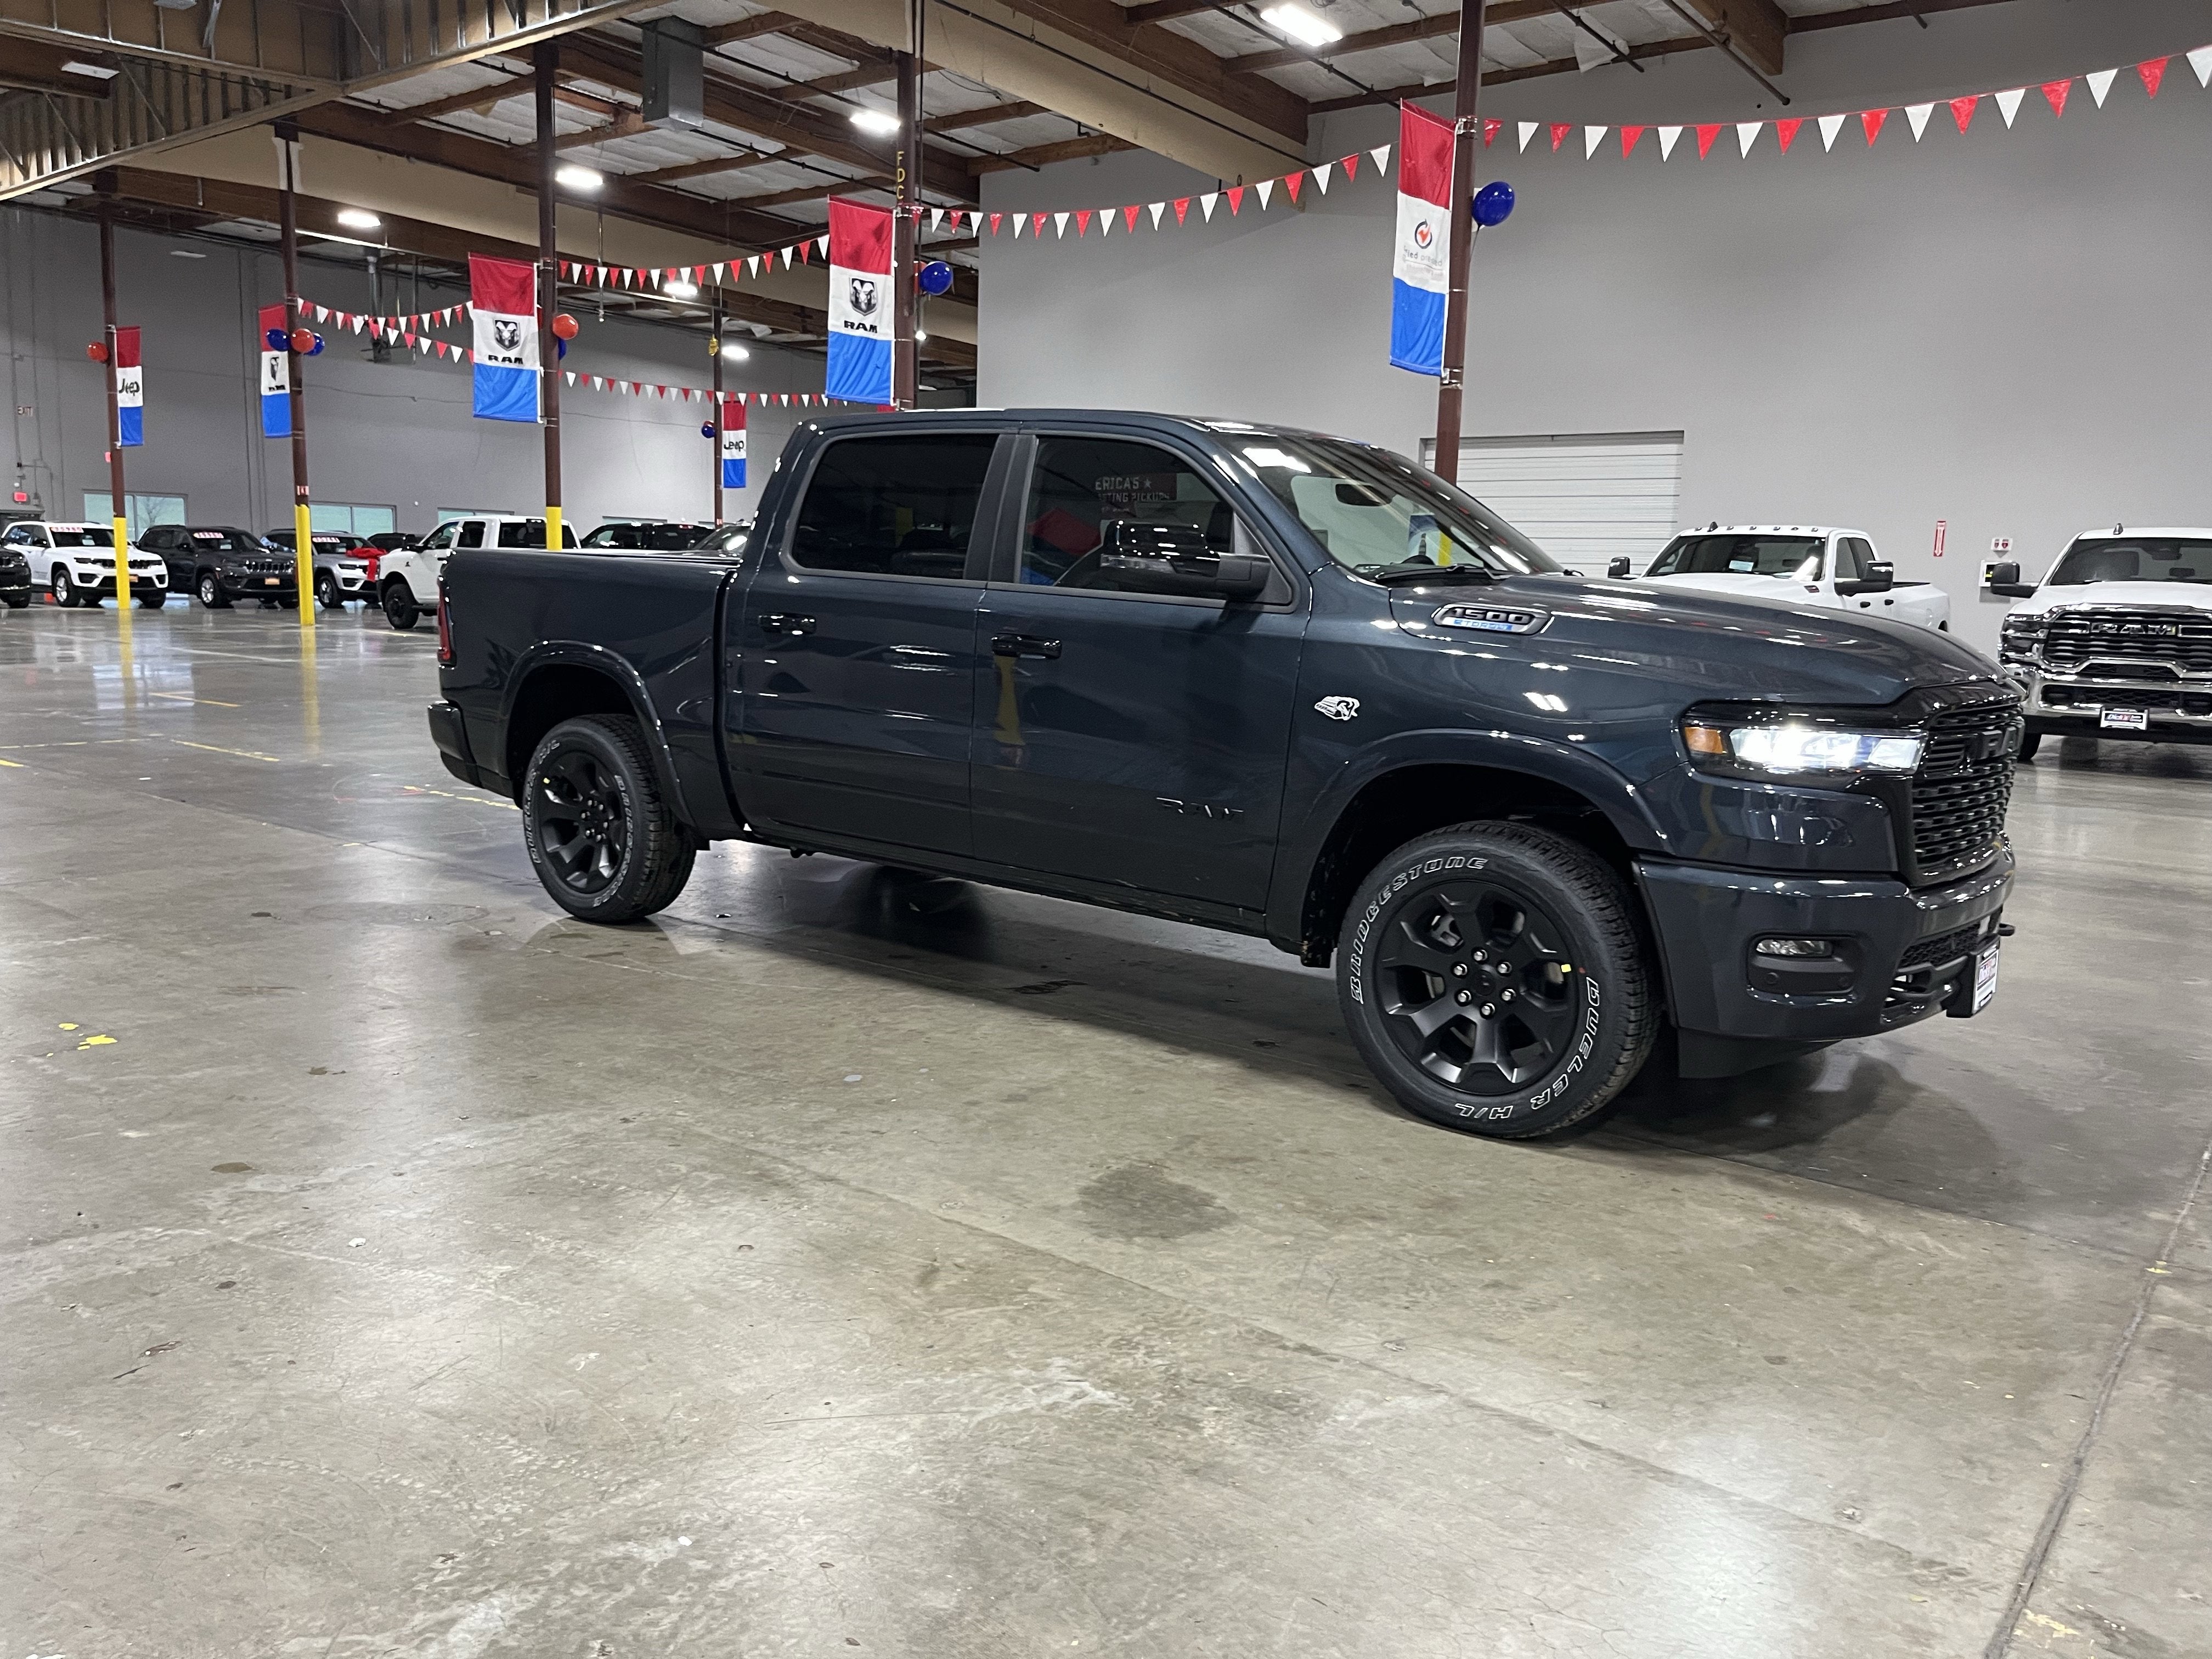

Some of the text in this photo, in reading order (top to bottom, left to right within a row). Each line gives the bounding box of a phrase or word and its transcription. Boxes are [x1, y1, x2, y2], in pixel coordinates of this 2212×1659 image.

[844, 320, 878, 334] RAM
[488, 354, 523, 365] RAM
[724, 440, 744, 452] Jeep
[1453, 607, 1531, 624] 1500
[2091, 622, 2176, 636] RAM
[1350, 856, 1488, 1004] BRIDGESTONE
[1455, 977, 1600, 1120] DUELER H/L
